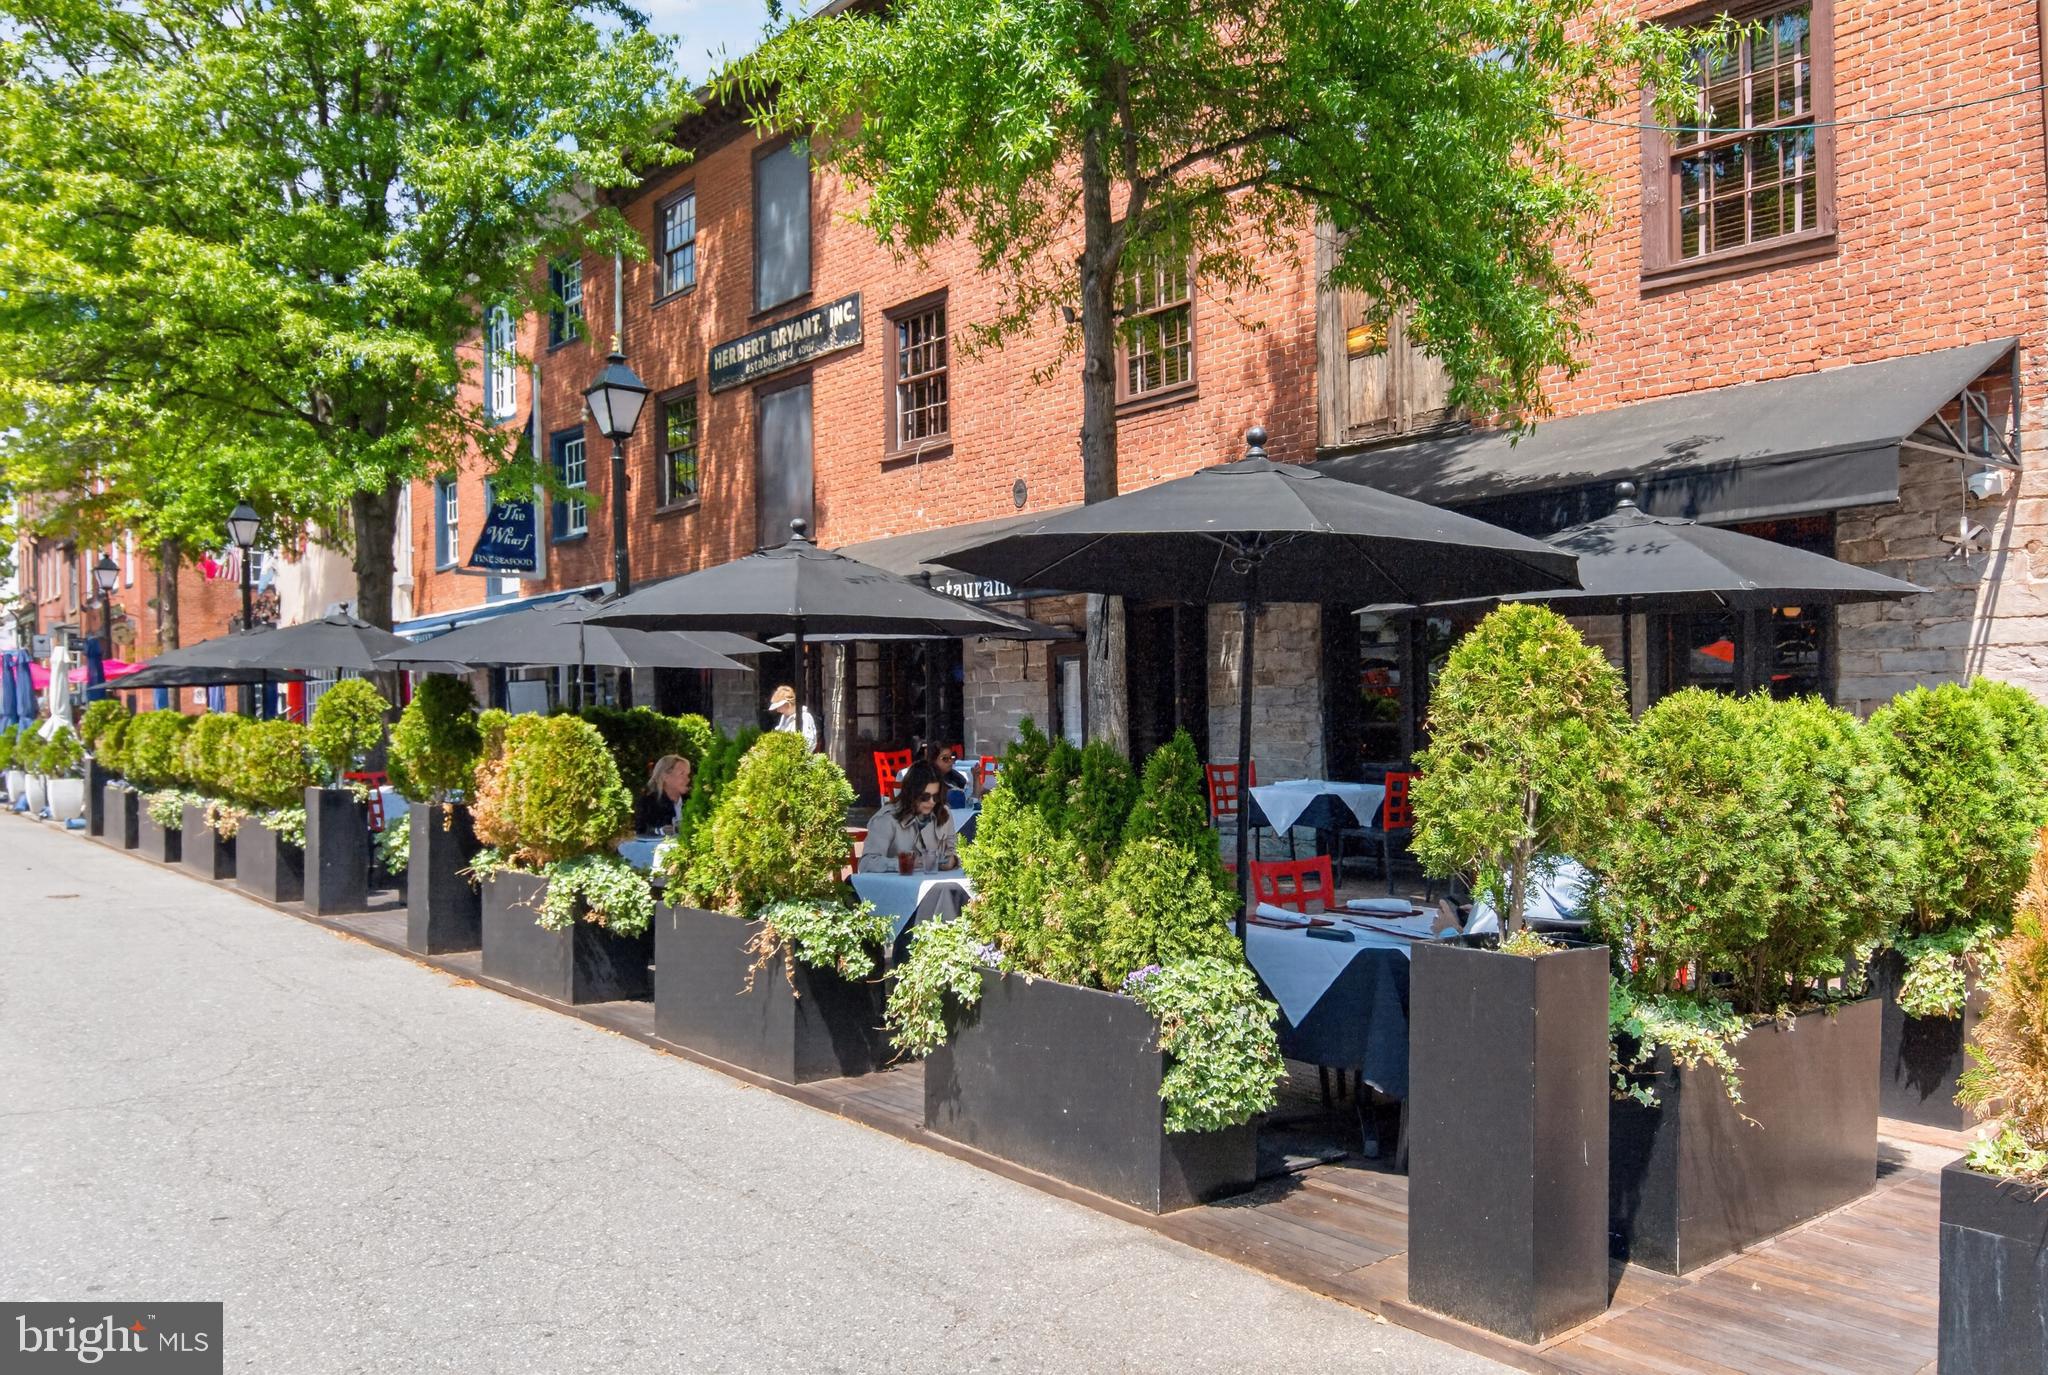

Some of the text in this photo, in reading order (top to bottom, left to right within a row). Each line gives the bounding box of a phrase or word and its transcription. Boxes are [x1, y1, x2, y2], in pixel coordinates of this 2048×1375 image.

[714, 336, 766, 371] HERBERT
[829, 301, 856, 328] INC.
[745, 344, 793, 374] established
[497, 503, 526, 521] The
[487, 526, 533, 552] Wharf
[475, 554, 533, 566] FINE SEAFOOD
